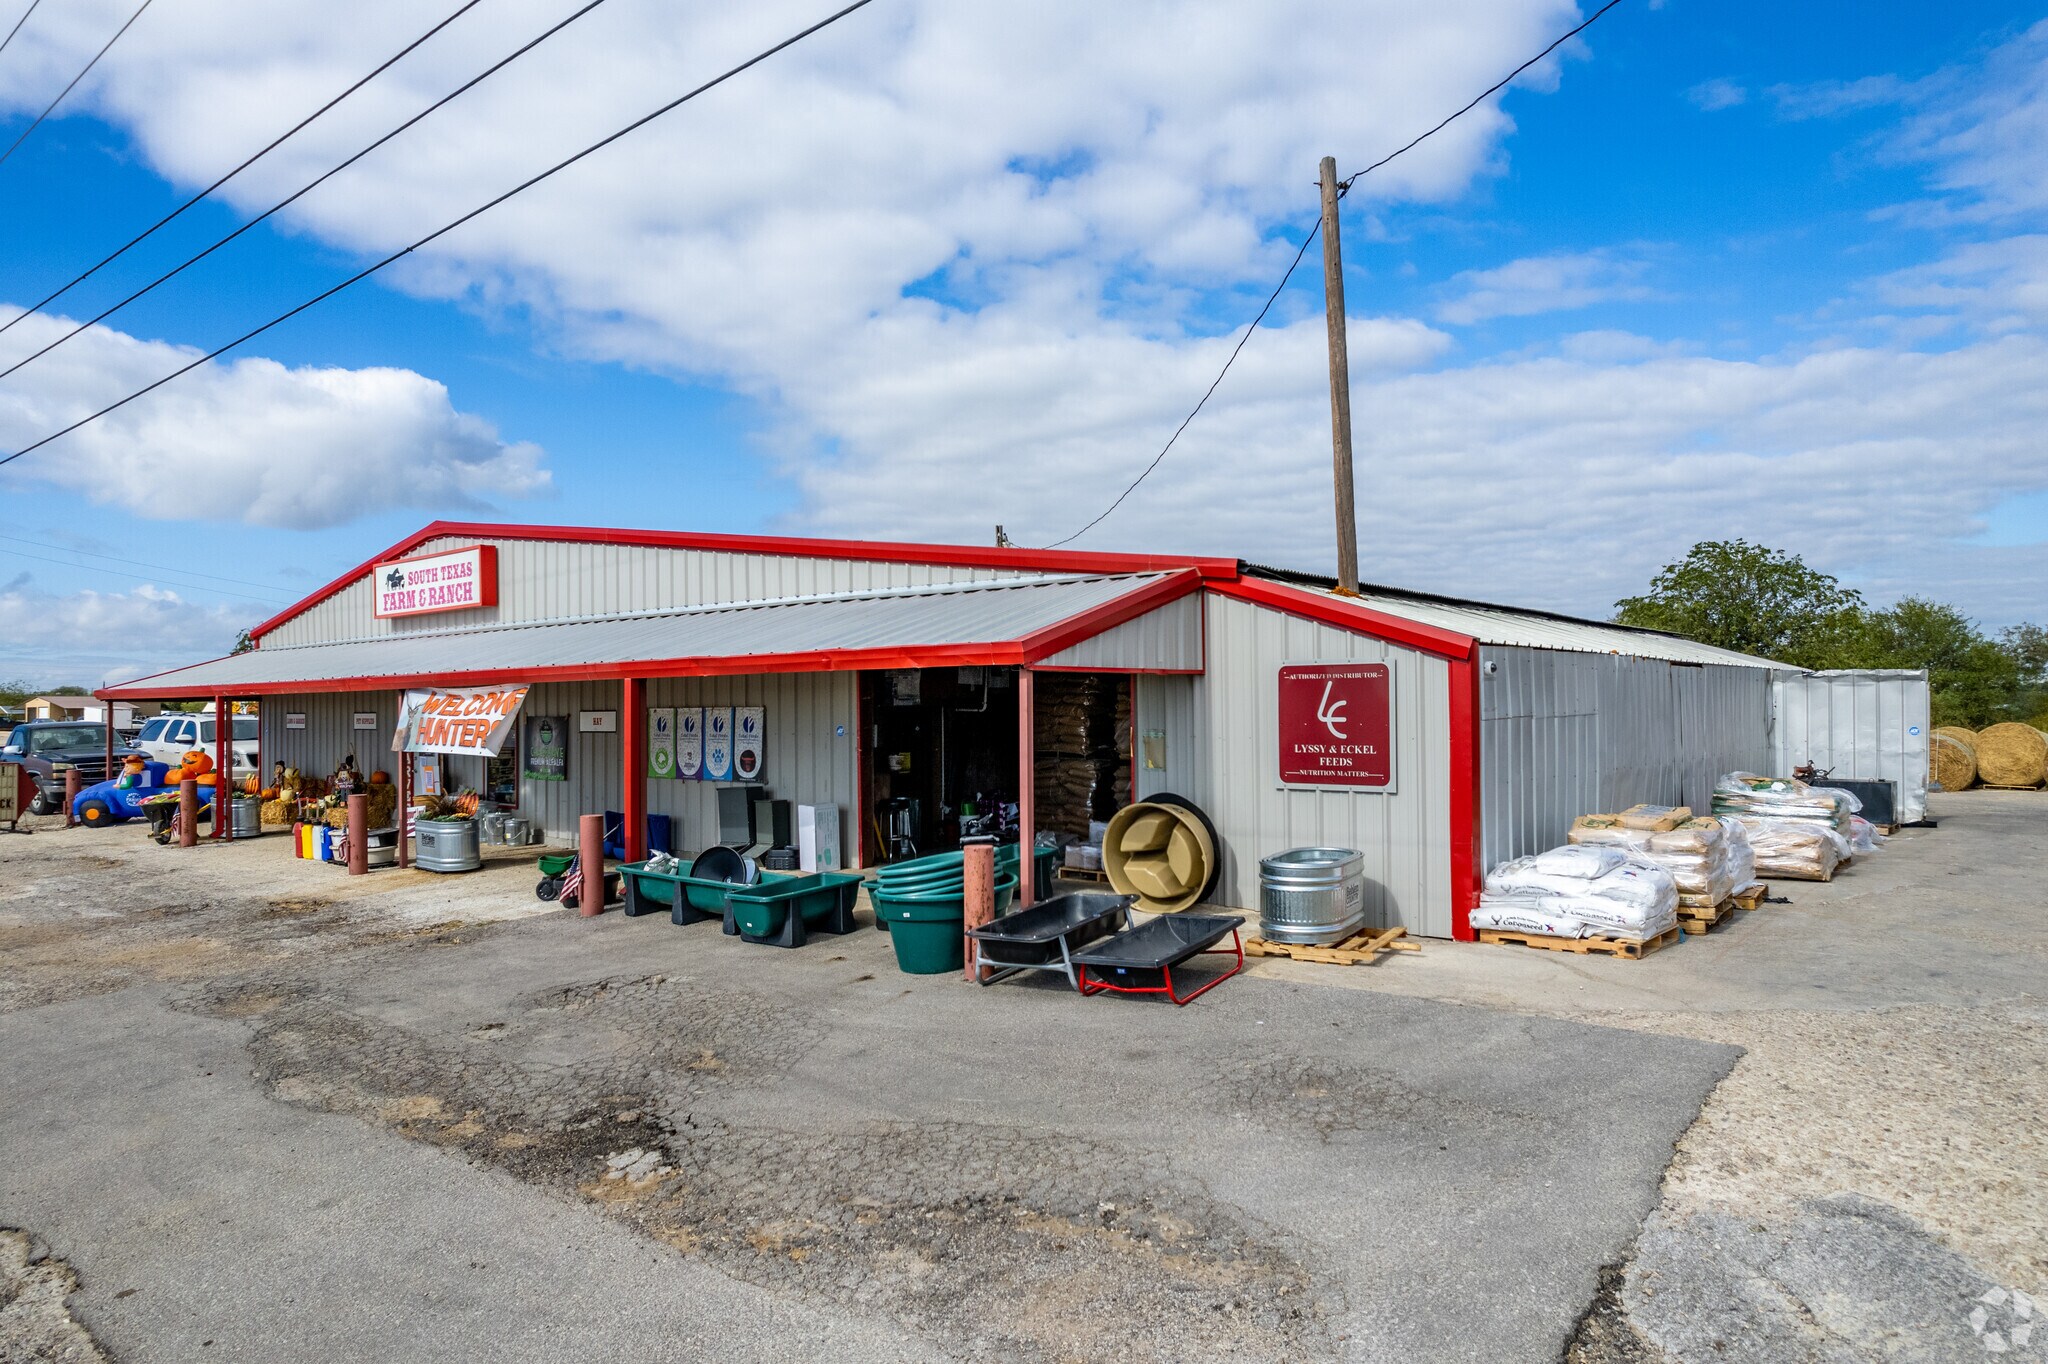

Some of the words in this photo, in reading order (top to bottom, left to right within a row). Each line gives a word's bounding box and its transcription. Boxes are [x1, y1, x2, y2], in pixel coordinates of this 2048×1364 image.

[408, 567, 438, 586] SOUTH
[441, 562, 472, 580] TEXAS
[383, 589, 416, 612] FARM
[428, 581, 473, 606] RANCH
[422, 687, 528, 717] WELCOME
[1294, 744, 1326, 754] LYSSY
[1329, 745, 1337, 754] &
[1340, 745, 1377, 755] ECKEL
[1320, 757, 1353, 766] FEEDS
